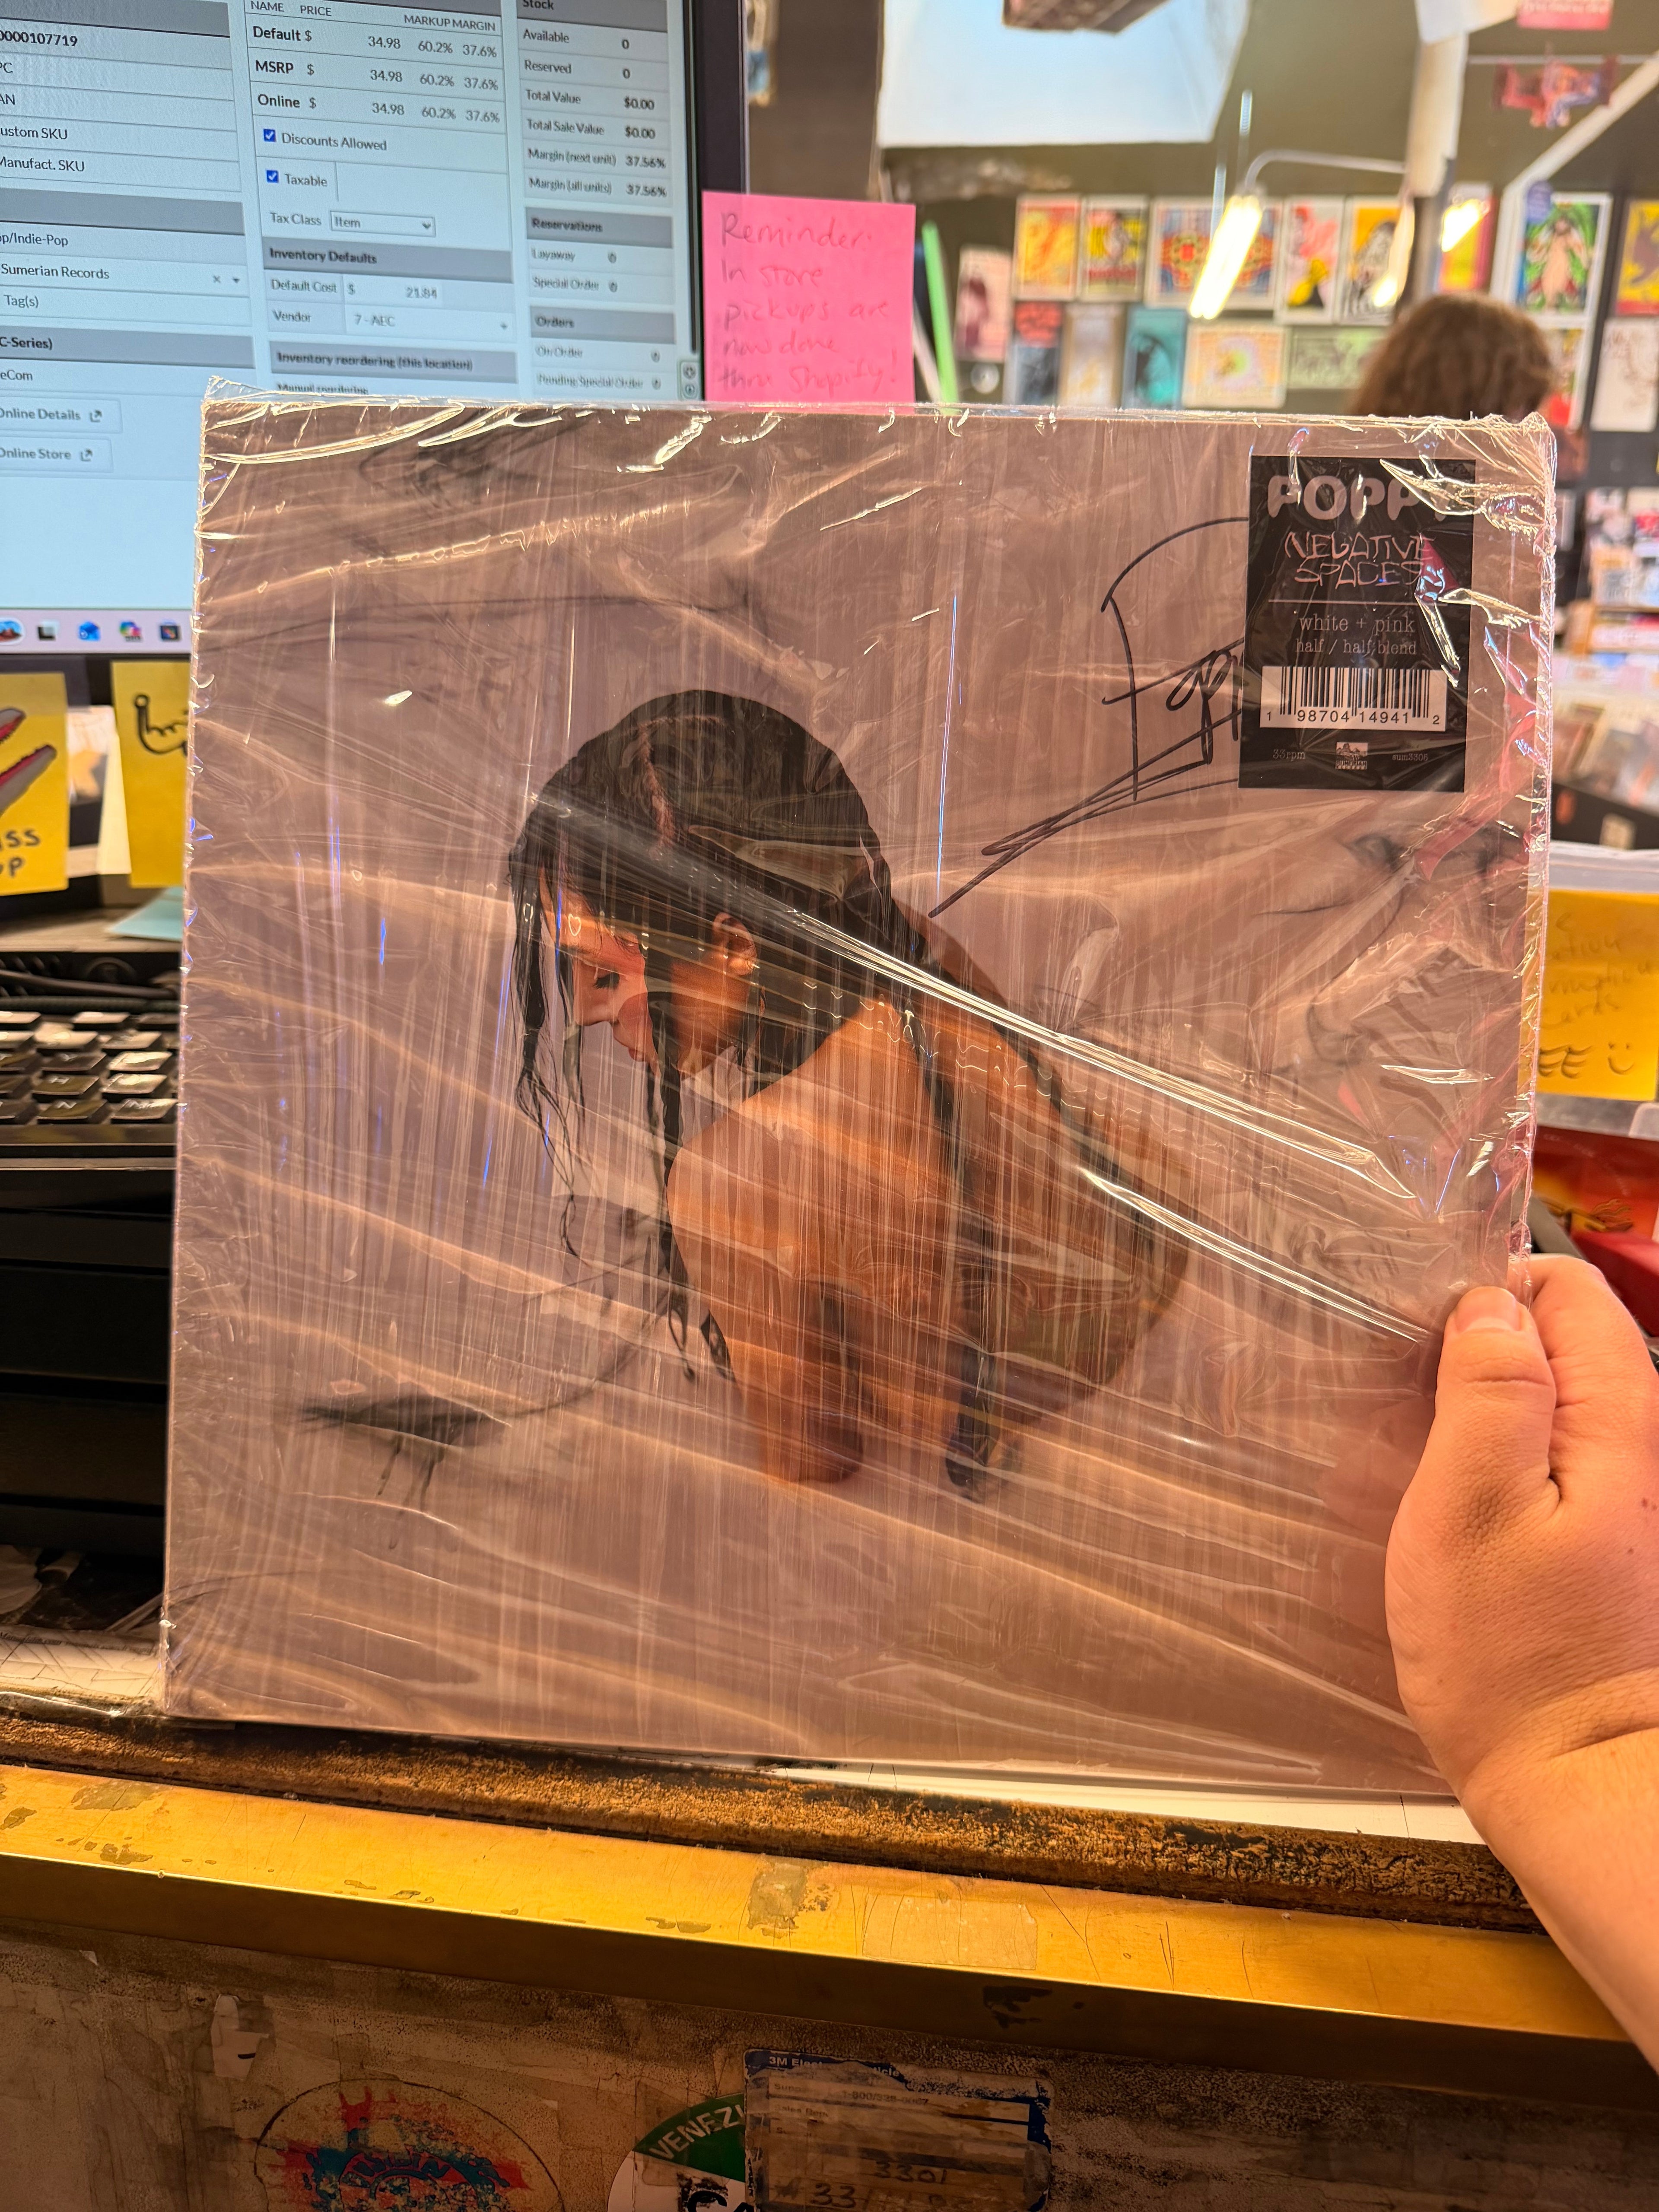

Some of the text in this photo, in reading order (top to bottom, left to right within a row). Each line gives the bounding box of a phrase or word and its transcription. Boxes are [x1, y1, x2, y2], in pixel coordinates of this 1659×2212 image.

[522, 0, 554, 10] Stock
[251, 0, 496, 32] NAME PRICE MARKUP MARGIN
[252, 25, 497, 58] Default $ 34.98 60.2% 37.6%
[522, 29, 630, 50] Available 0
[0, 62, 13, 73] C
[255, 60, 499, 91] MSRP $ 34.98 60.2% 37.6%
[524, 59, 631, 79] Reserved 0
[257, 93, 500, 124] Online $ 34.98 60.2% 37.6%
[525, 89, 655, 111] Total Value $0.00
[0, 126, 67, 140] ustom SKU
[527, 118, 656, 140] Total Sale Value $0.00
[281, 132, 388, 151] Discounts Allowed
[58, 160, 85, 172] SKU
[528, 148, 565, 163] Margin
[625, 155, 666, 169] 37.56%
[285, 173, 328, 187] Taxable
[270, 212, 361, 229] Tax Class Item
[531, 217, 603, 233] Reservations
[270, 248, 378, 265] Inventory Defaults
[1, 263, 110, 280] Sumerian Records
[721, 258, 823, 288] In store
[271, 279, 310, 292] Default
[312, 281, 337, 294] Cost
[3, 294, 39, 308] Tag(s)
[272, 310, 311, 323] Vendor
[535, 315, 575, 329] Orders
[724, 297, 889, 332] pickups are
[781, 329, 839, 356] done
[276, 351, 333, 366] Inventory
[334, 356, 396, 370] reordering
[397, 357, 423, 370] (this
[0, 370, 33, 381] eCom
[38, 409, 81, 421] Details
[38, 449, 72, 461] Store
[1267, 475, 1447, 522] POPP
[1284, 531, 1436, 562] NEGATIVE
[1299, 613, 1349, 632] white
[1374, 616, 1416, 636] pink
[1295, 639, 1417, 655] half / half blend
[1266, 710, 1440, 725] 1 98704 14941 2
[1272, 749, 1306, 761] 33rpm
[769, 2056, 787, 2066] 3M
